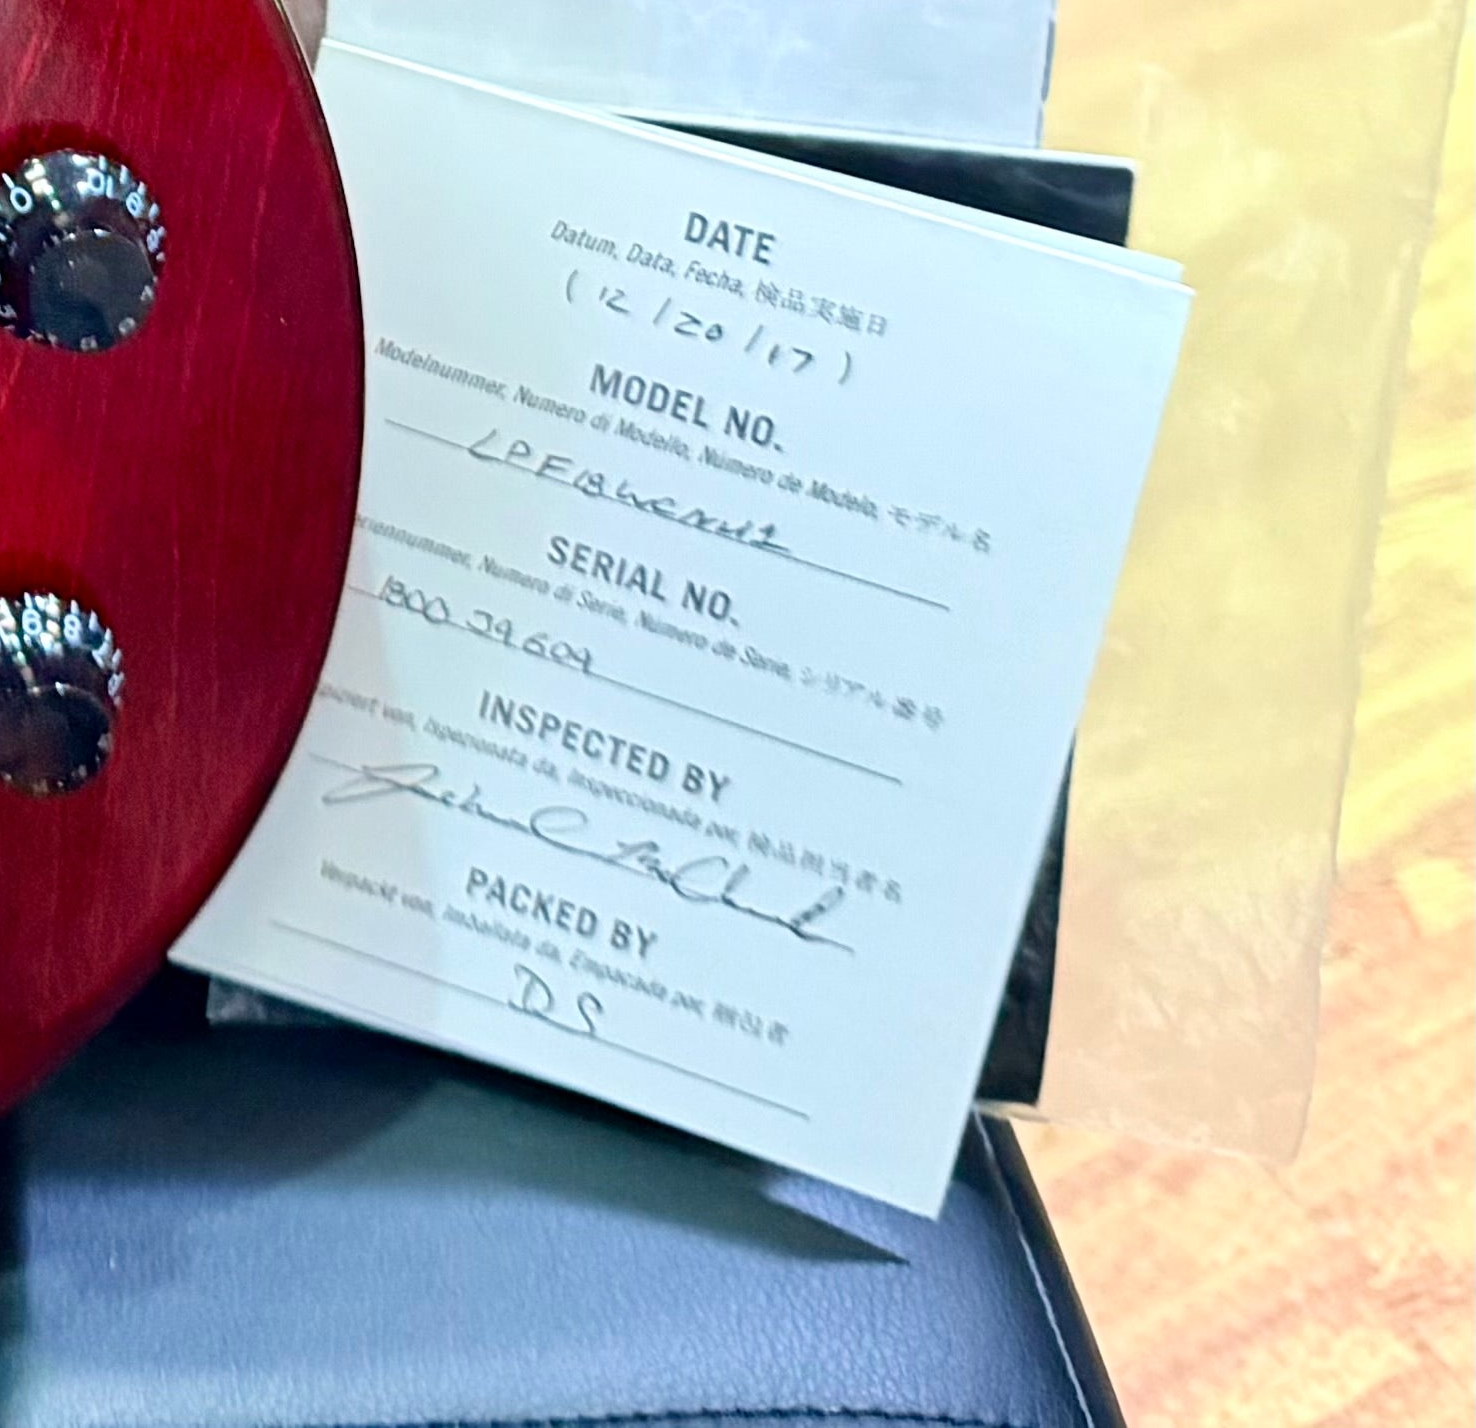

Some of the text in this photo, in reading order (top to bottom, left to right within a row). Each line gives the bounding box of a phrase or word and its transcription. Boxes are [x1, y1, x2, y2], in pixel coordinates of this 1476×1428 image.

[550, 219, 618, 261] Datum,
[626, 242, 677, 278] Data,
[683, 261, 745, 298] Fecha,
[684, 211, 777, 265] DATE
[375, 337, 506, 400] Modelnummer,
[589, 362, 784, 454] MODEL NO.
[547, 535, 741, 627] SERIAL NO.
[479, 689, 731, 802] INSPECTED BY
[466, 866, 598, 938] PACKED
[610, 918, 658, 959] BY
